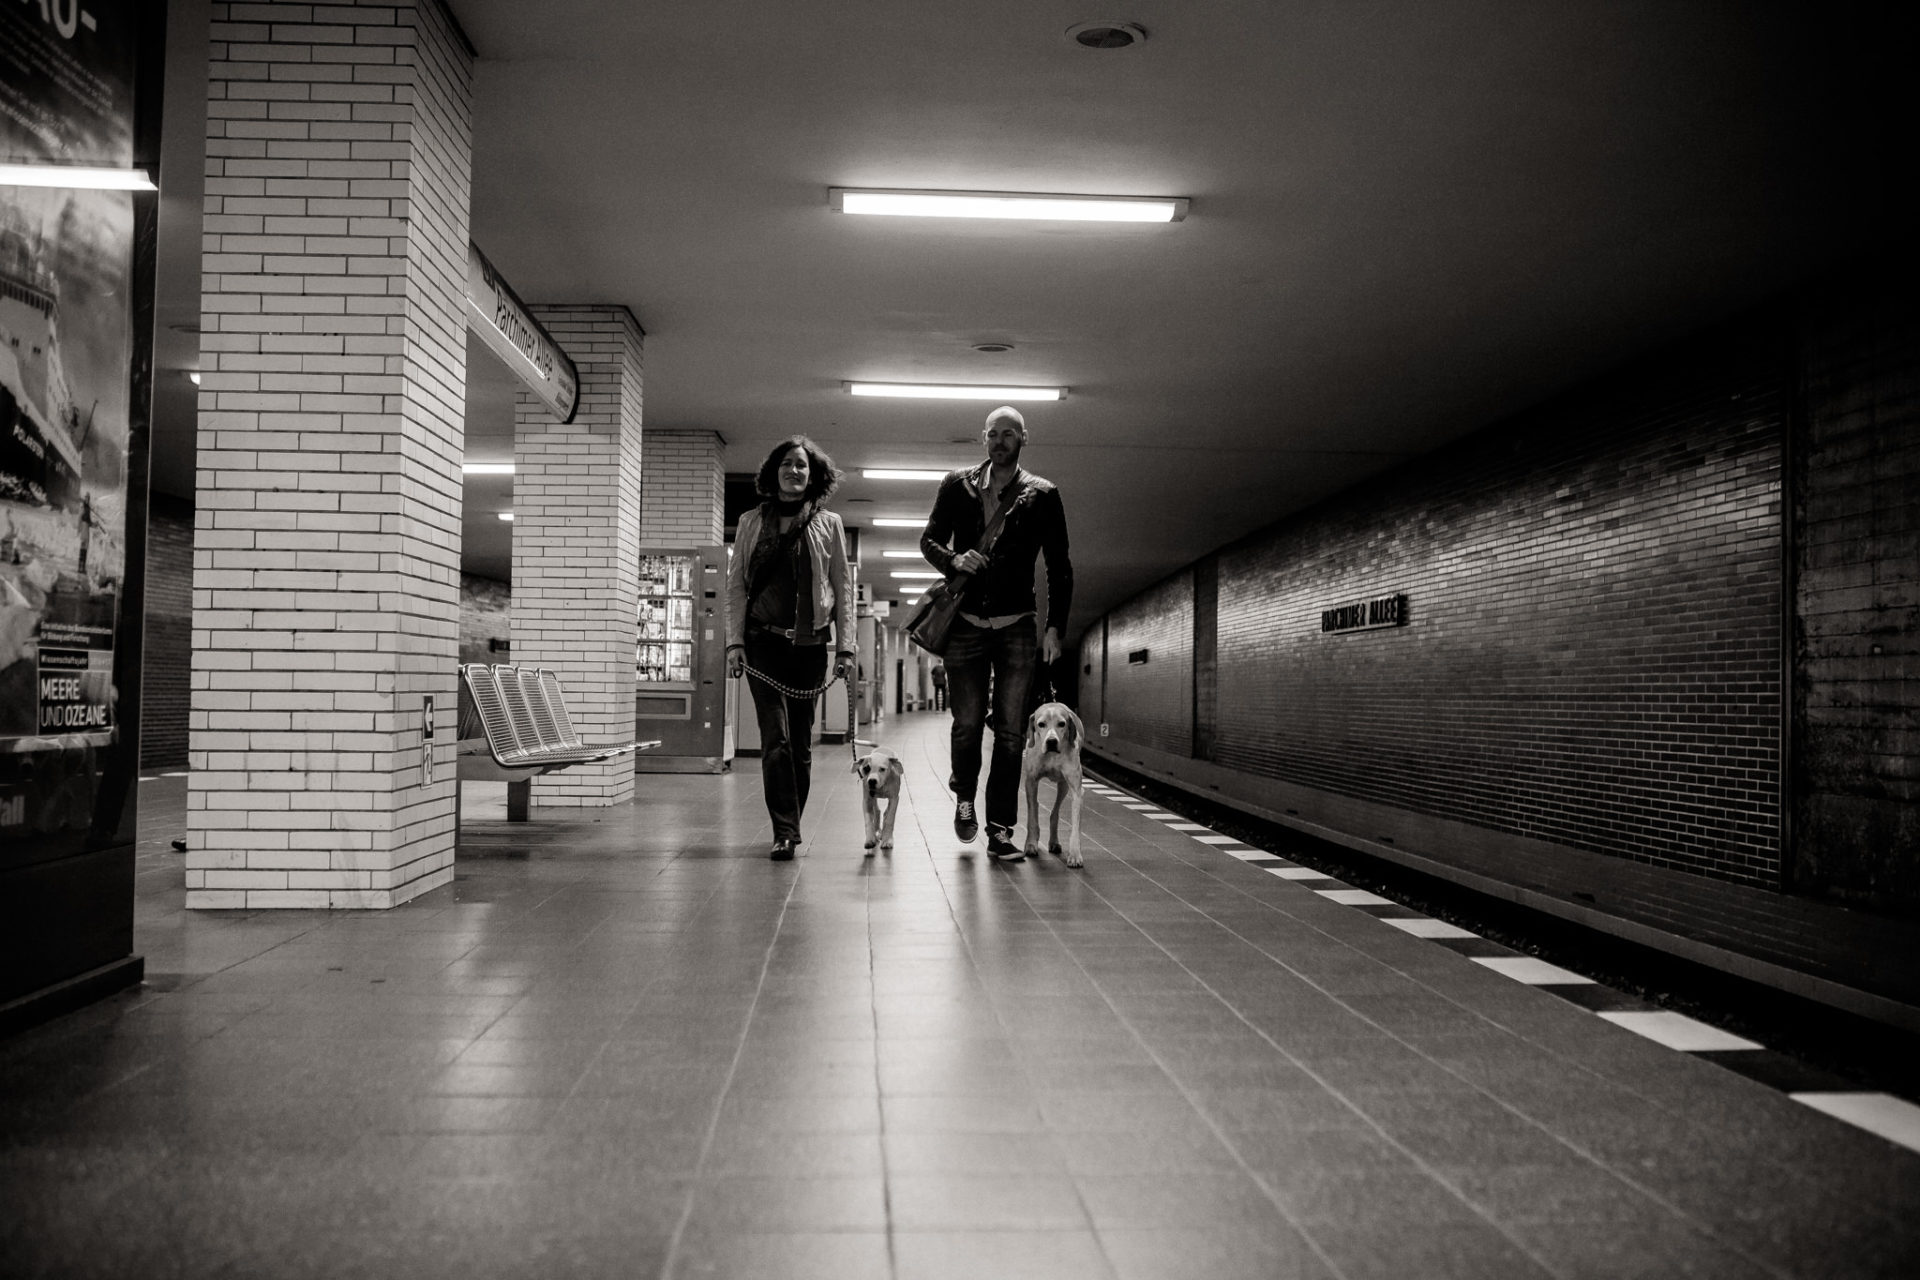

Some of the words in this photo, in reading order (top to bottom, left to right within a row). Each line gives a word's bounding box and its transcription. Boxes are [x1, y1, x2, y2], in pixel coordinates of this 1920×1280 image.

[494, 288, 535, 361] Parchimer
[534, 334, 554, 382] Allee
[1321, 603, 1366, 632] PARCHIMER
[1369, 596, 1397, 625] ALLEE
[41, 678, 81, 701] MEERE
[41, 706, 64, 727] UND
[65, 704, 107, 727] OZEANE
